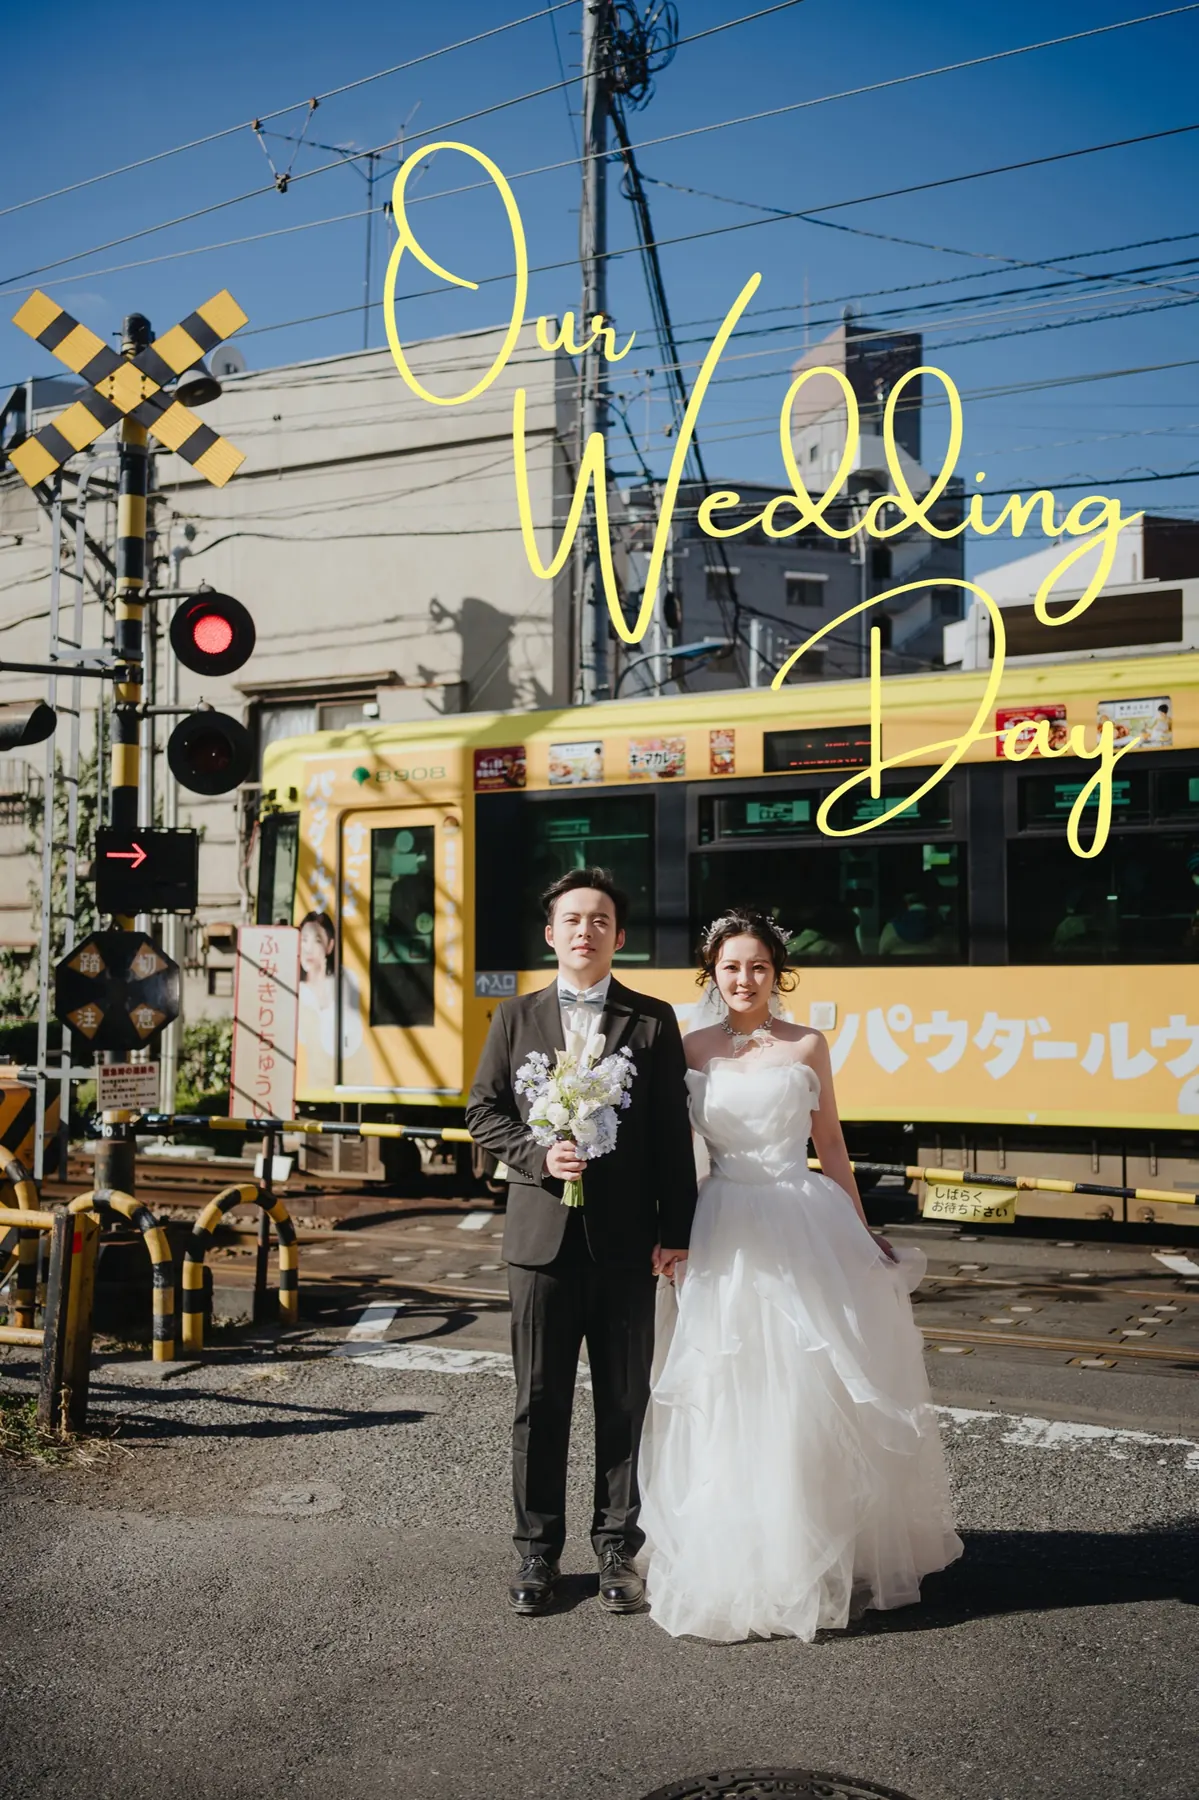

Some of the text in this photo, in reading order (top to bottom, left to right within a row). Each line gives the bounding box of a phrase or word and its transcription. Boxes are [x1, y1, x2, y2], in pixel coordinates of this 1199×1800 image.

[630, 752, 680, 766] キーマカレー
[375, 766, 447, 783] 8908
[490, 974, 516, 989] 入口
[252, 935, 279, 1120] ふみきりちゅうい
[935, 1187, 983, 1203] しばらく
[931, 1201, 1008, 1218] お待ち下さい
